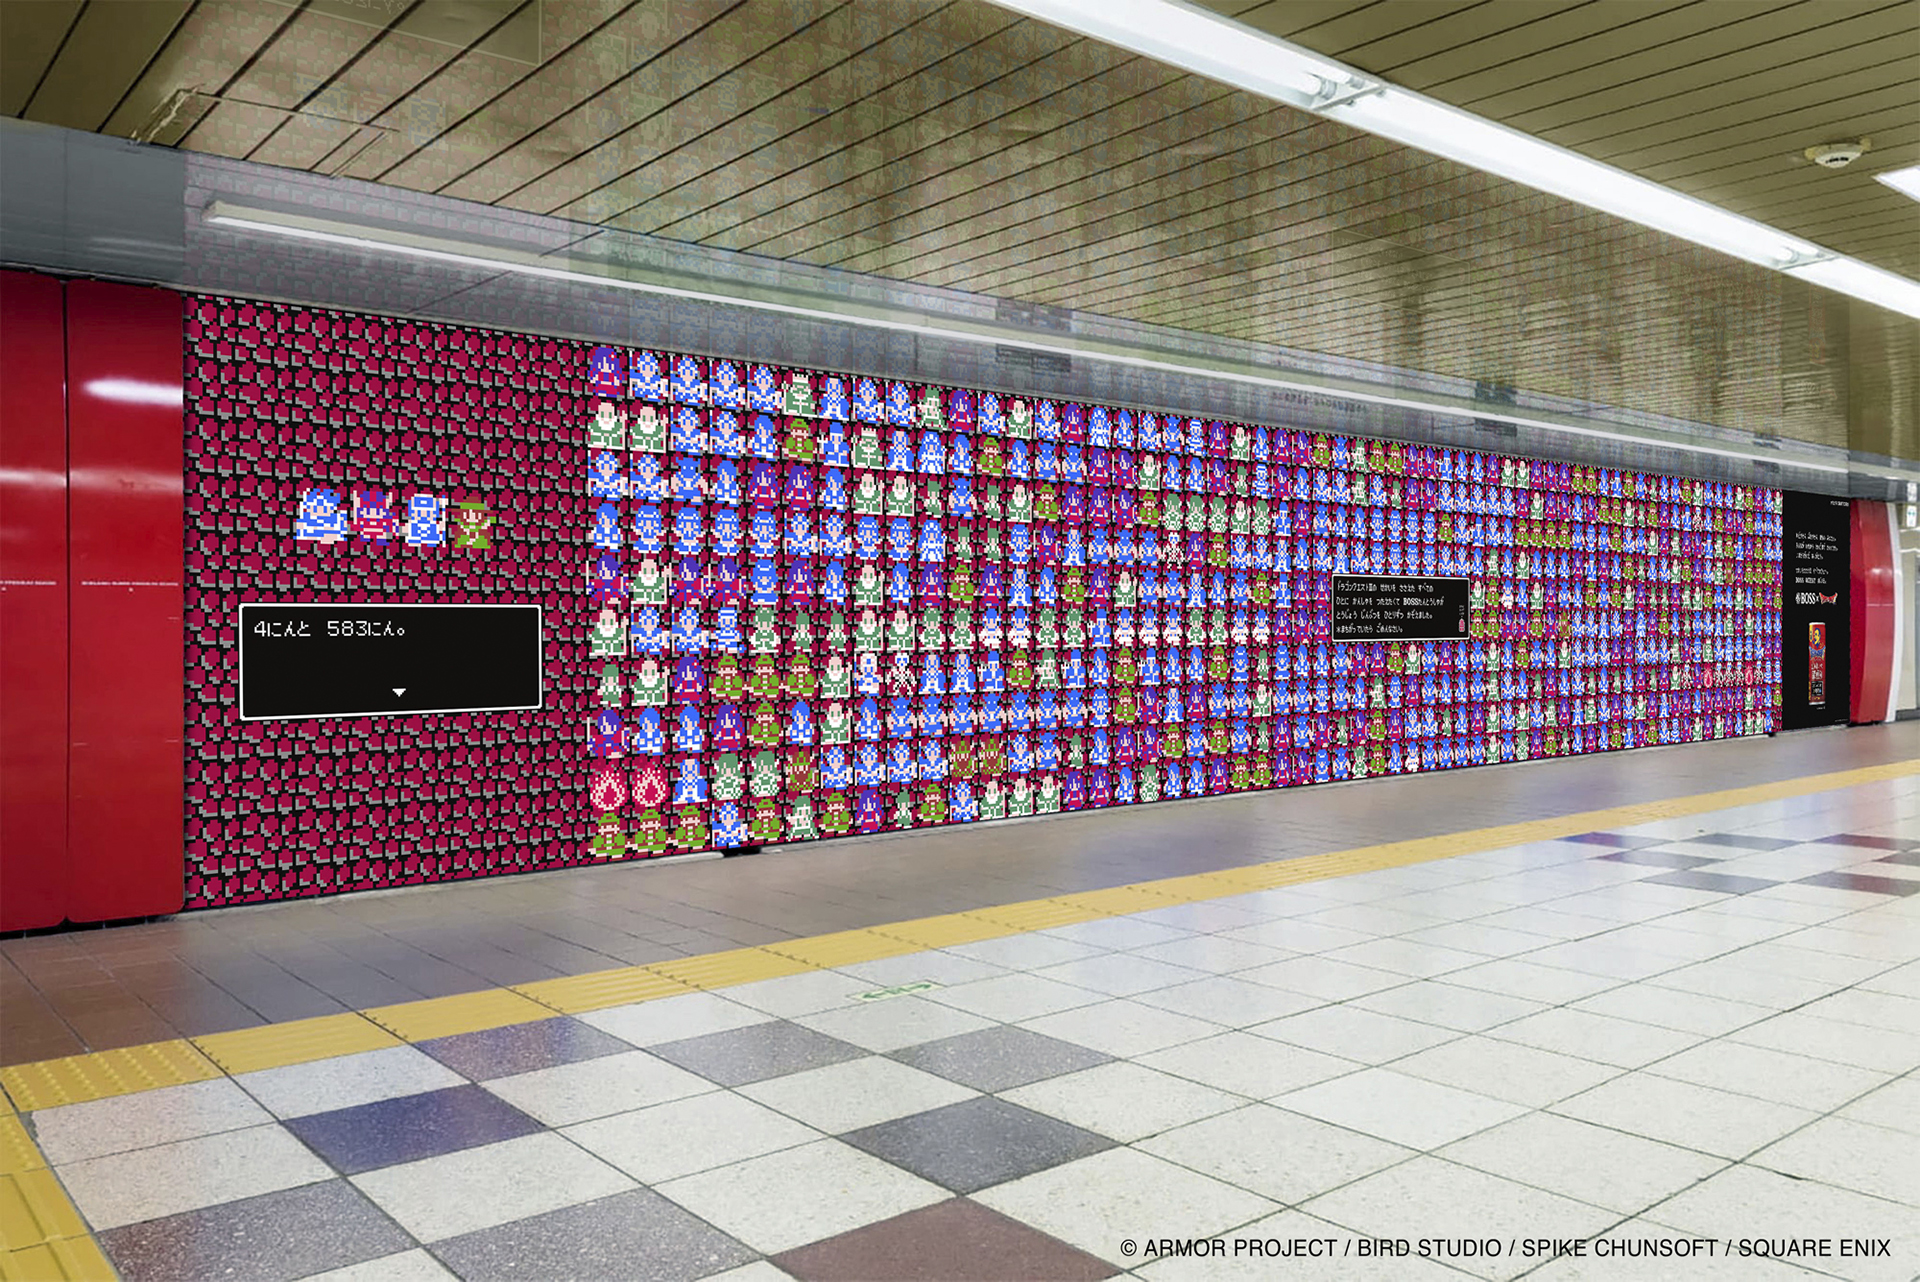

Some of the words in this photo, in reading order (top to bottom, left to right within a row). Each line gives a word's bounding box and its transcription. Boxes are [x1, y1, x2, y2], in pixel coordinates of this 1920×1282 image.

[1417, 582, 1434, 593] すべての
[1336, 596, 1349, 606] ひとに
[1352, 596, 1373, 606] かんしゃを
[1801, 592, 1816, 605] BOSS
[1336, 608, 1358, 620] とうじょう
[1360, 608, 1381, 620] じんぶつを
[254, 620, 311, 637] 4にんと
[327, 620, 405, 637] 583にん。
[1376, 622, 1403, 634] ごめんなさい。
